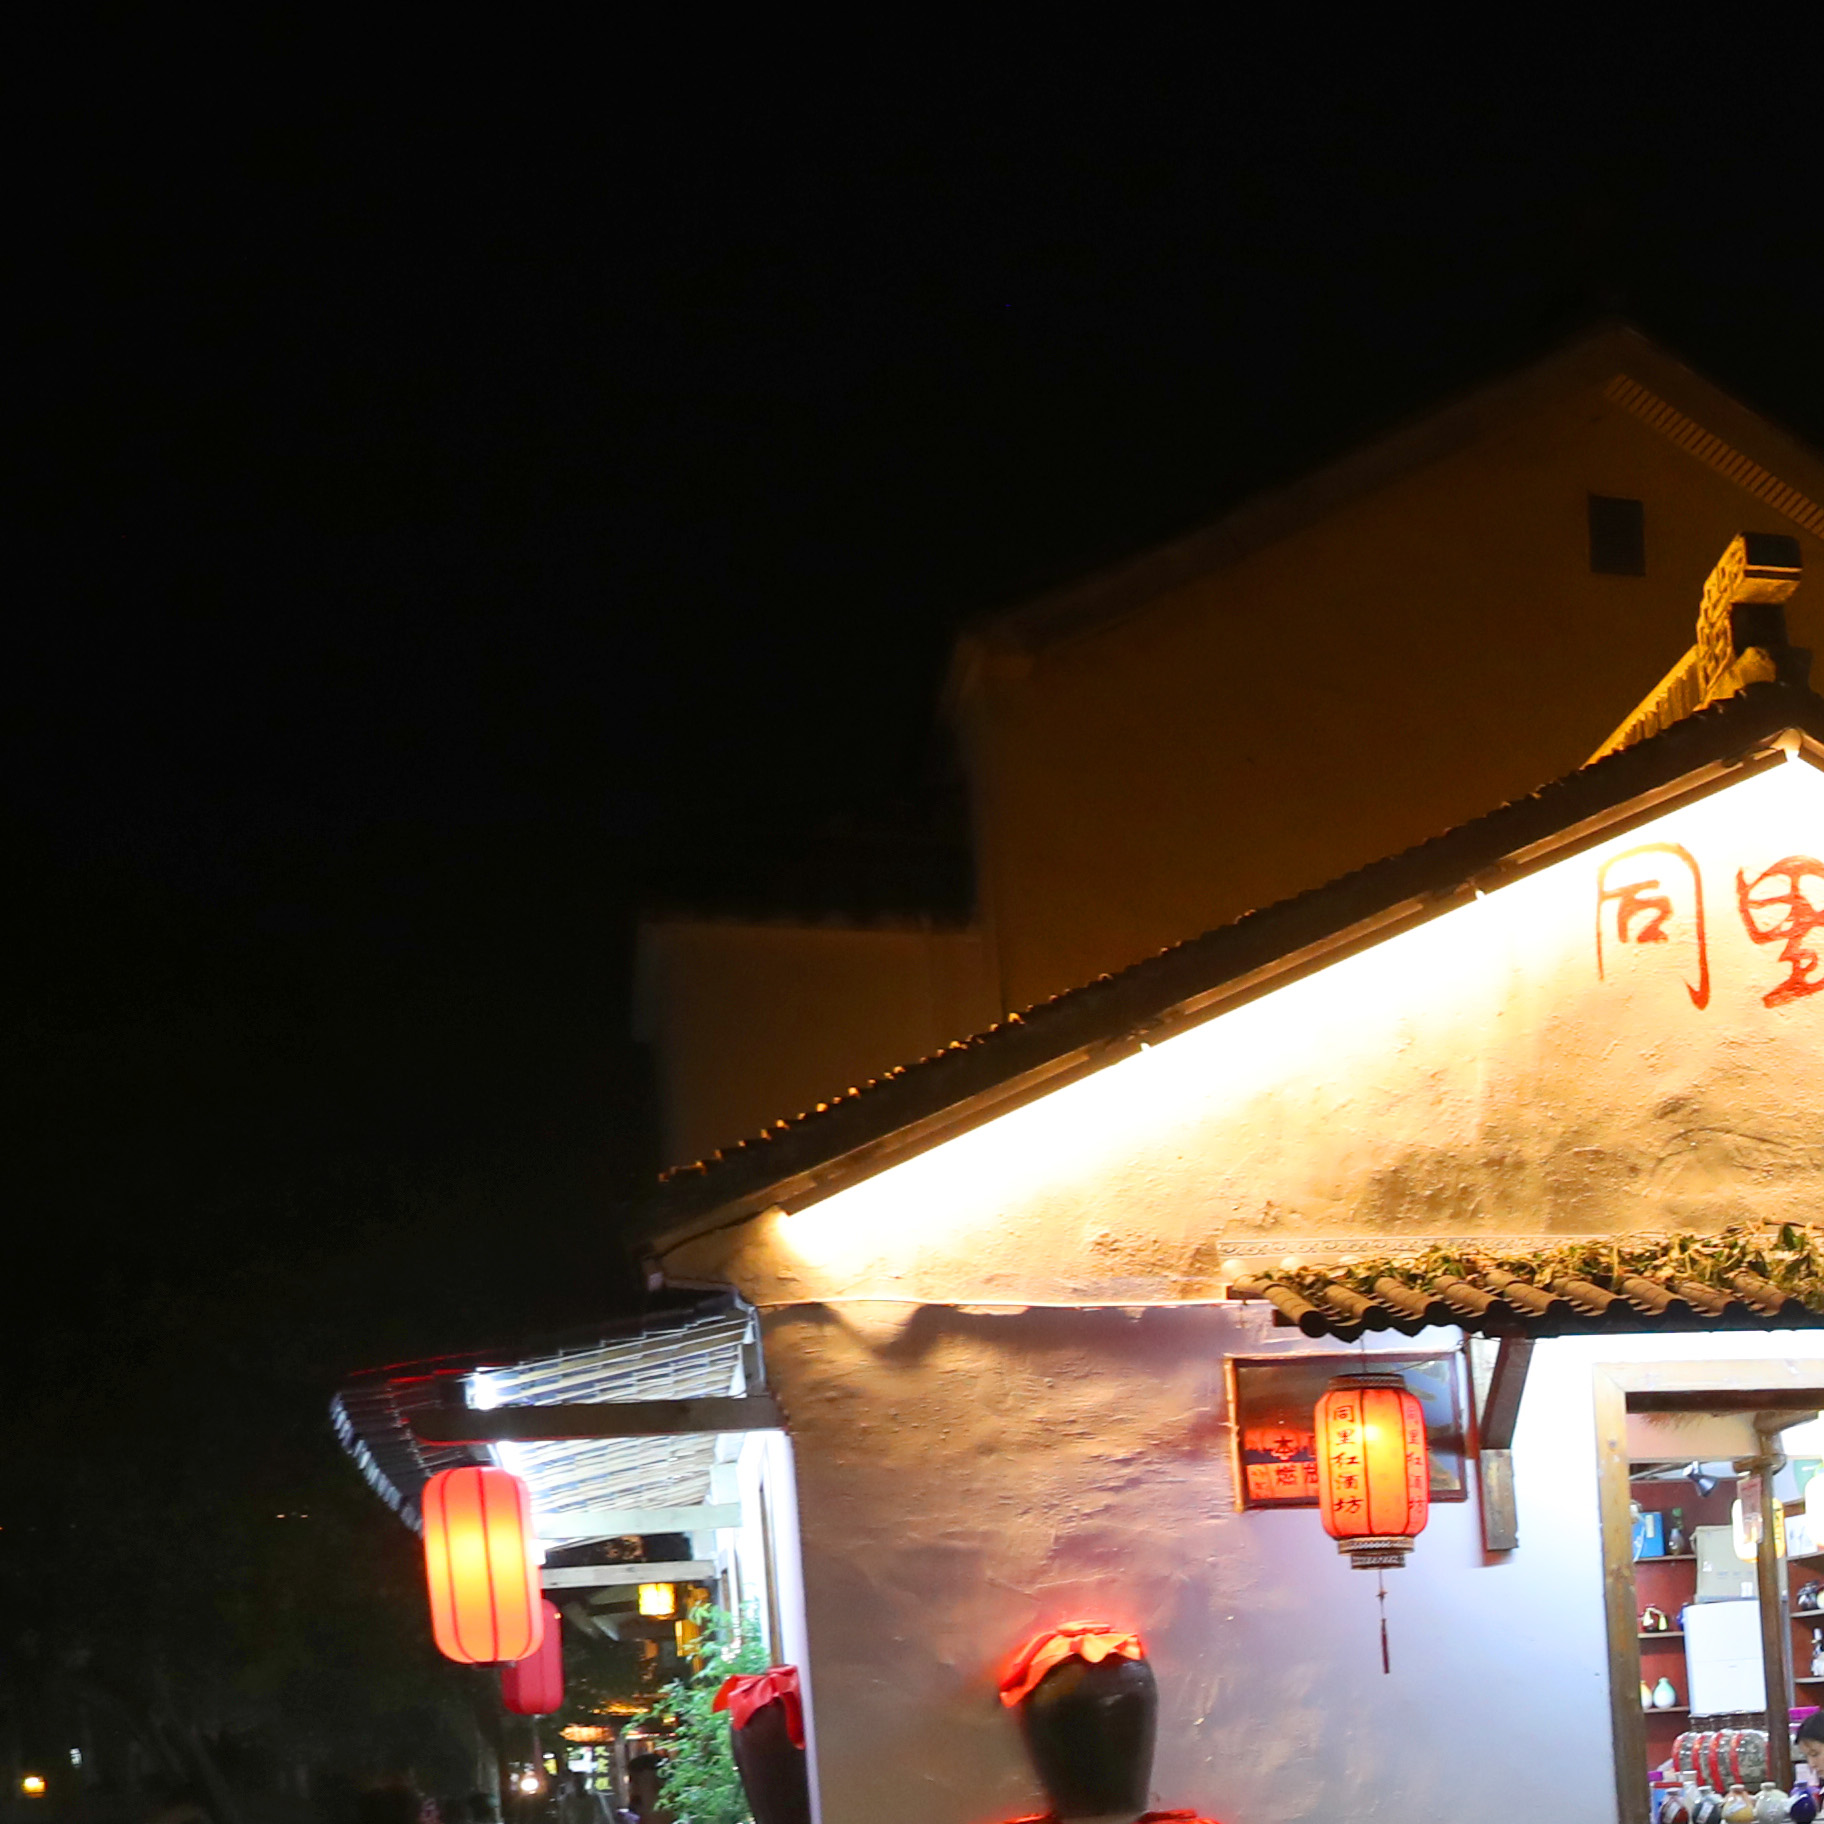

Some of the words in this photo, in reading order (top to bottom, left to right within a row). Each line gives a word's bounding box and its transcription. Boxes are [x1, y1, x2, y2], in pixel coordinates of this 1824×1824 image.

[1329, 1404, 1364, 1514] 同里红酒坊
